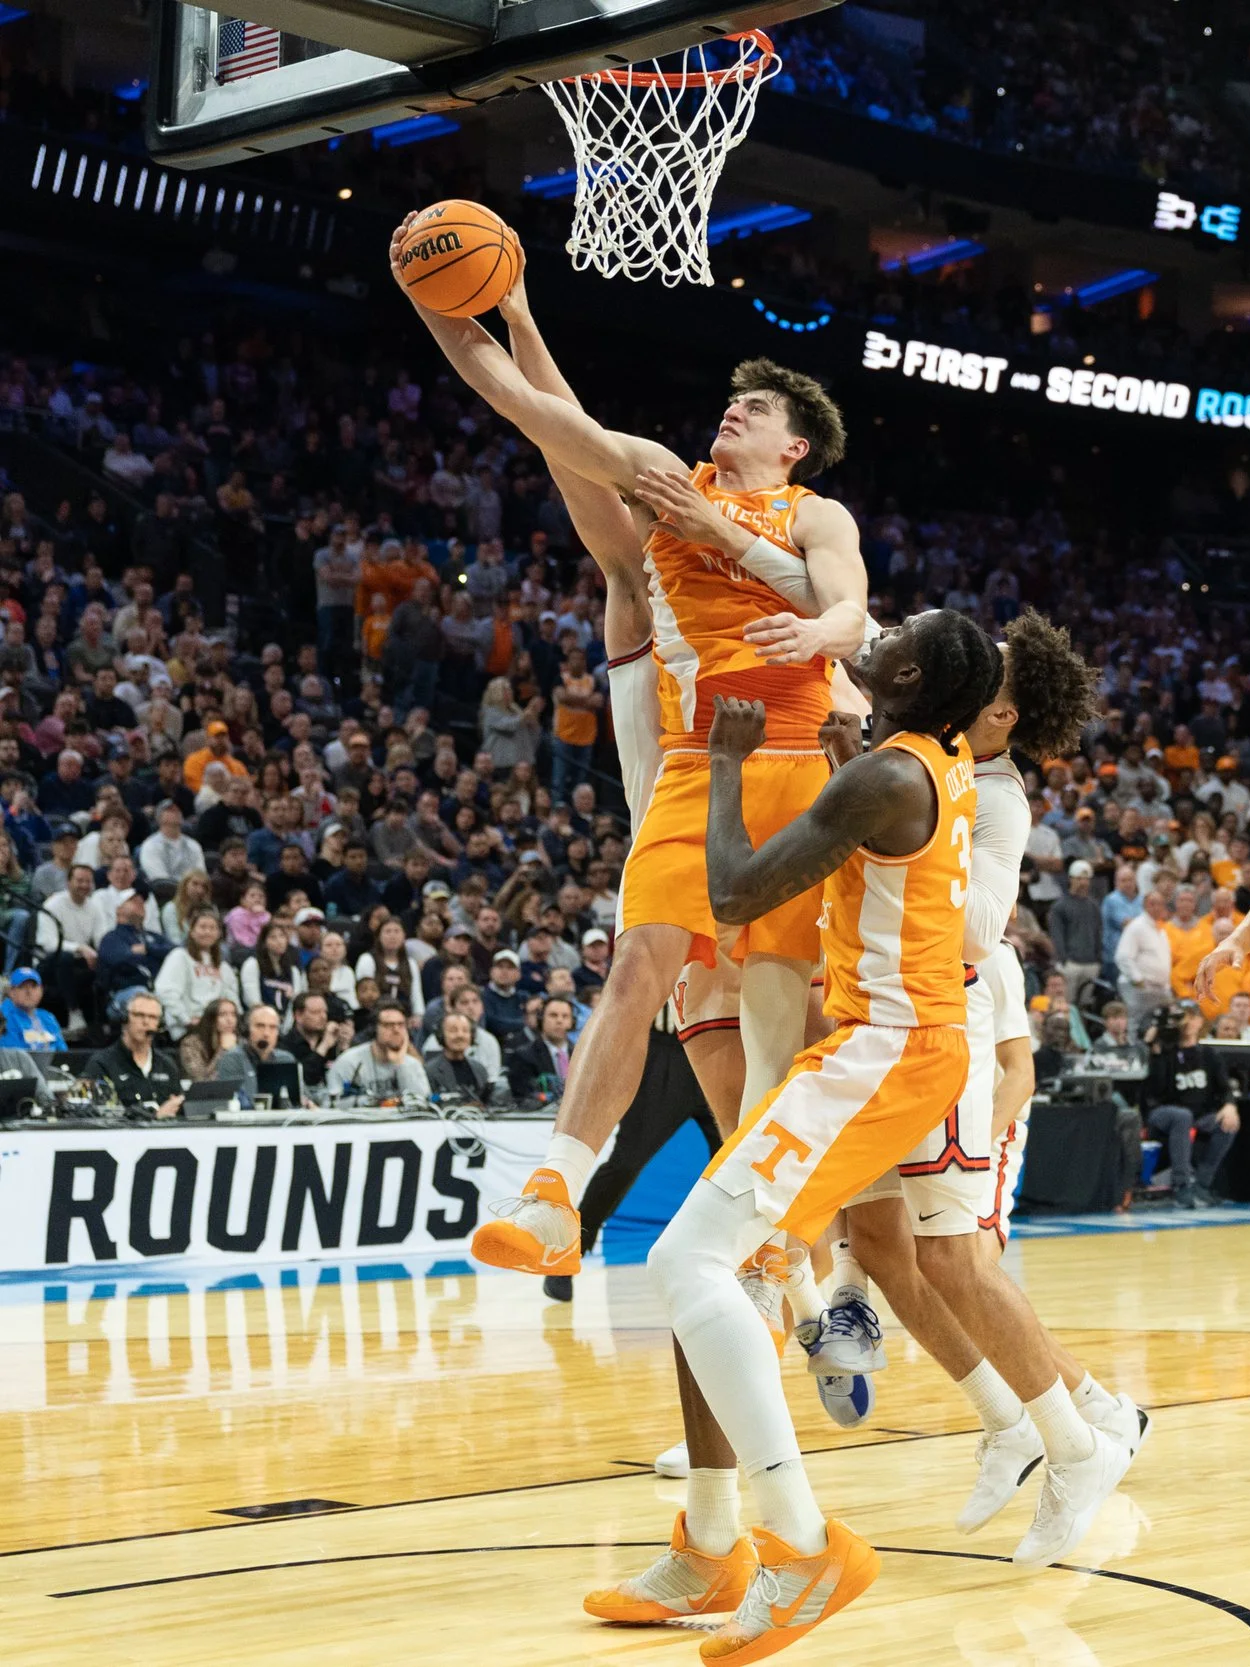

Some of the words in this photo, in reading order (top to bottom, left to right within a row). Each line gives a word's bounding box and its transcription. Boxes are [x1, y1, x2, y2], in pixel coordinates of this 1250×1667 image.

[400, 231, 463, 270] Wilson
[903, 340, 1008, 393] FIRST
[1046, 367, 1191, 418] SECOND
[751, 1120, 812, 1183] T
[45, 1137, 487, 1265] ROUNDS
